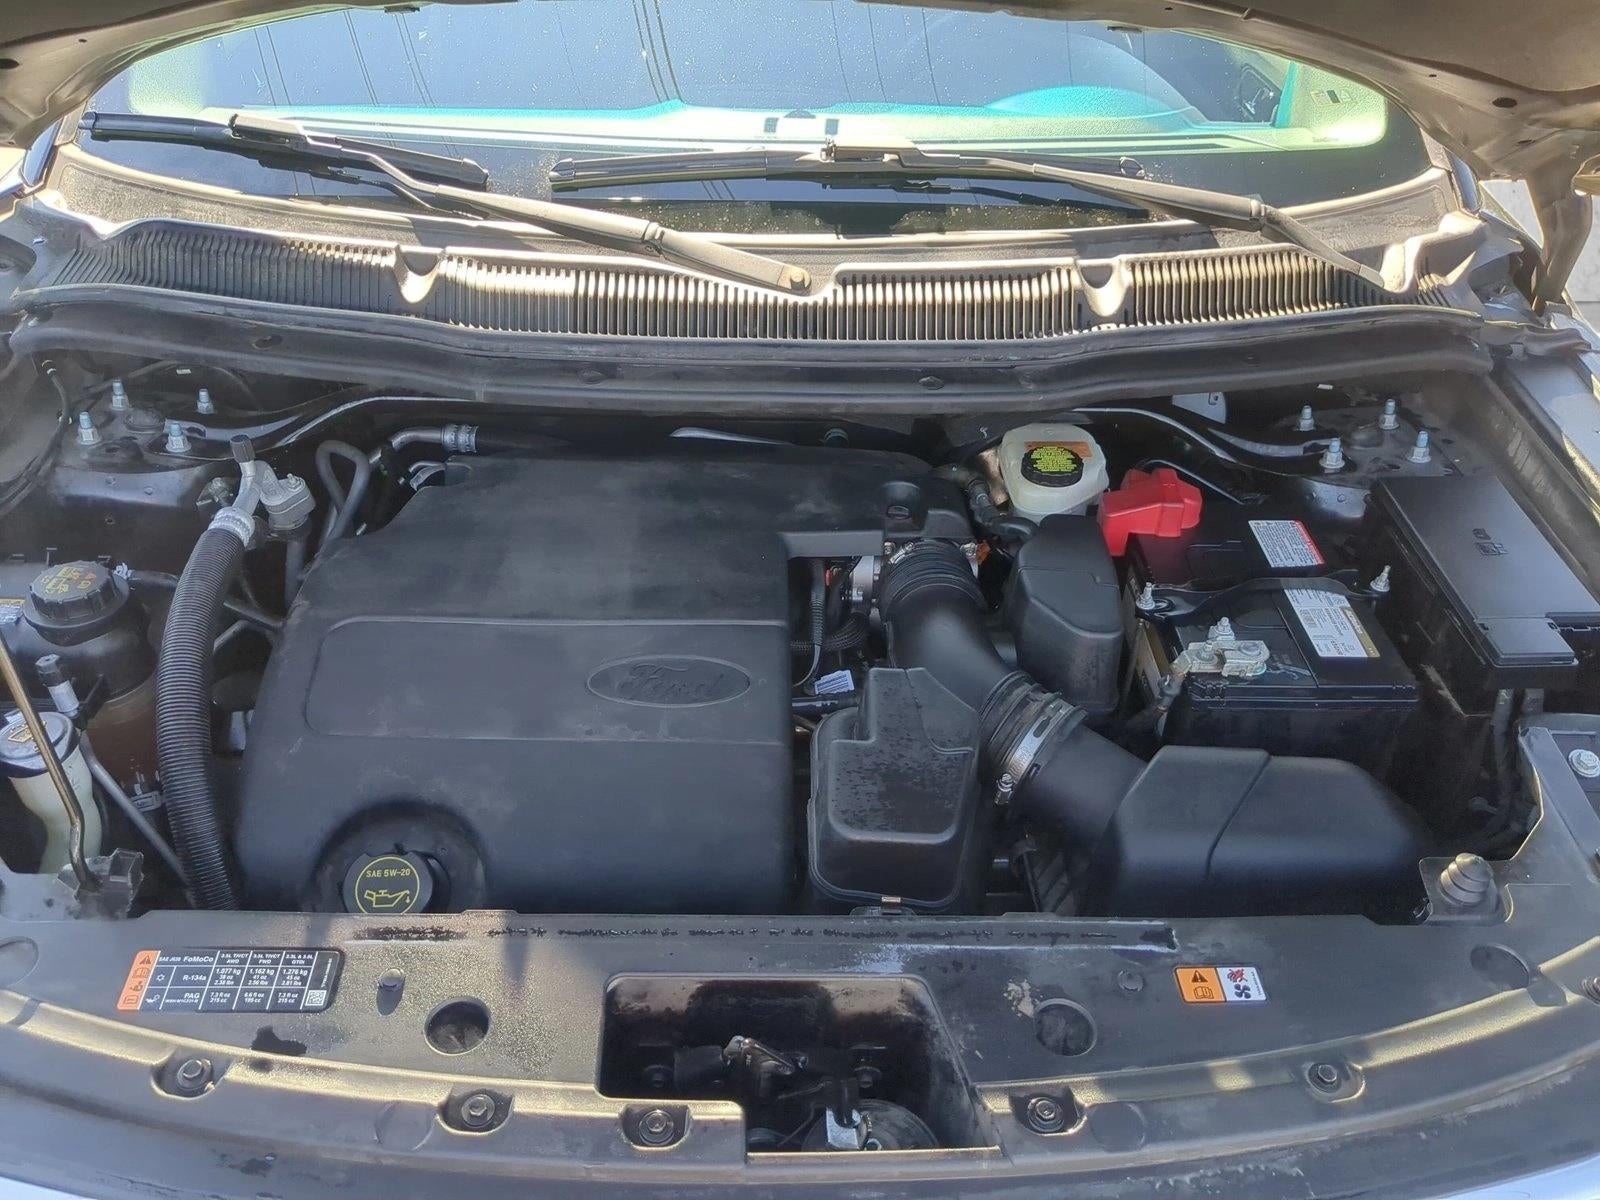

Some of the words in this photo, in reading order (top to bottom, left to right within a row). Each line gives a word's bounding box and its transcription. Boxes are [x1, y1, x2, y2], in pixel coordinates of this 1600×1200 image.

[366, 870, 382, 878] SAE
[384, 868, 411, 877] 5W-20
[233, 967, 241, 976] kg
[266, 968, 275, 976] kg
[299, 968, 308, 977] kg
